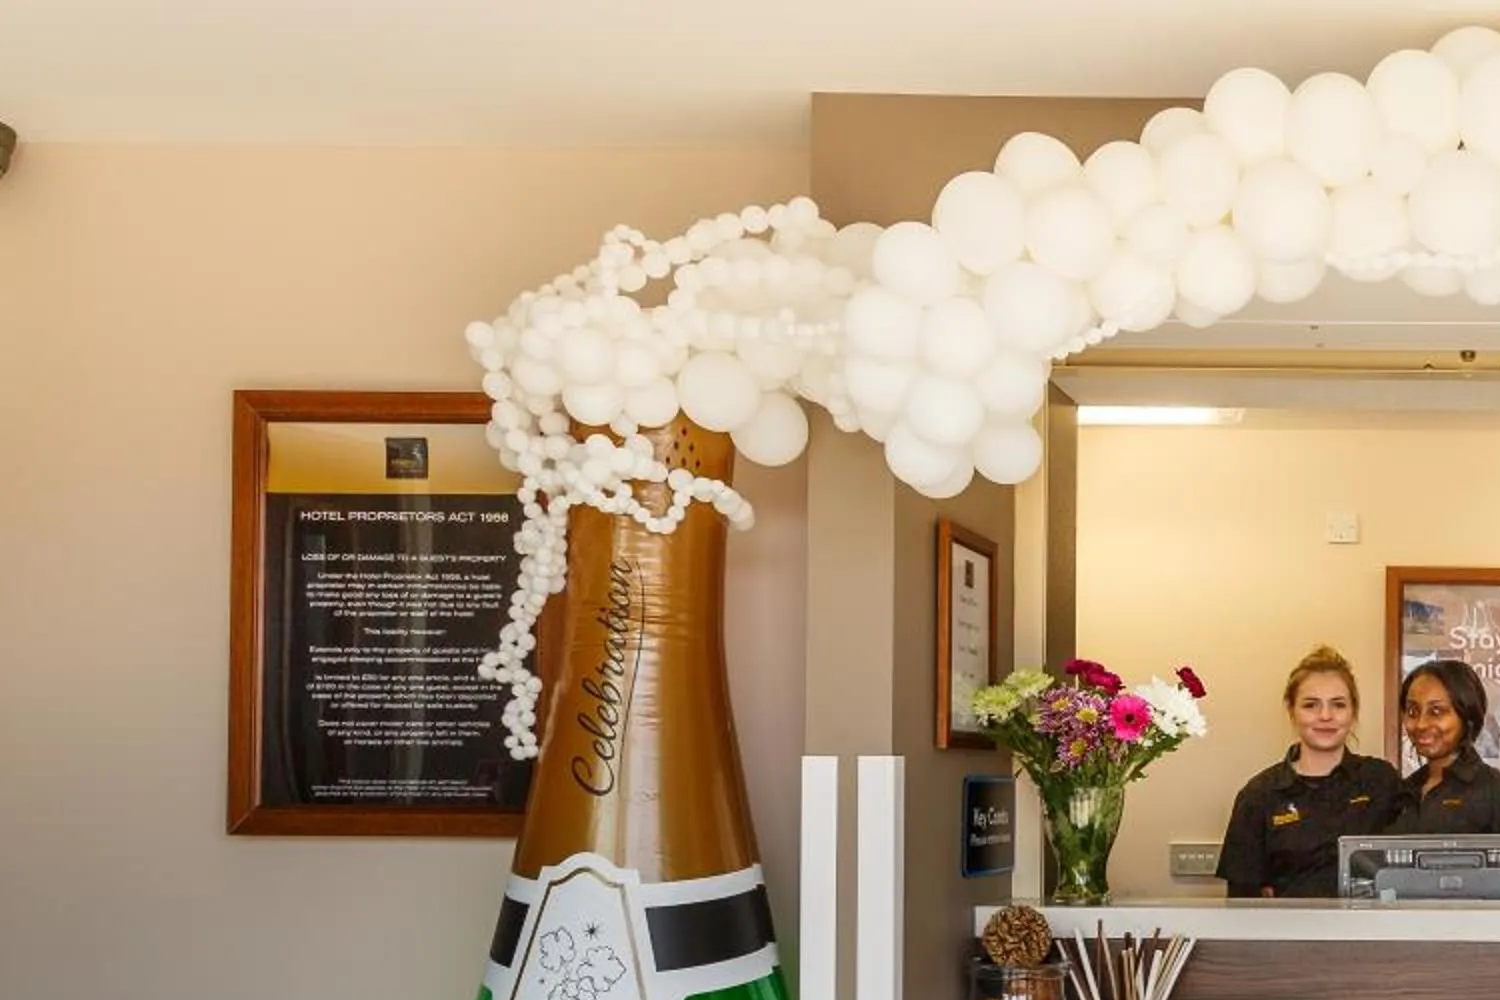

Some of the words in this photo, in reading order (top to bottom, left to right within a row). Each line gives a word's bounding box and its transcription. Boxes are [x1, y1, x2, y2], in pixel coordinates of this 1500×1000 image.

[301, 511, 345, 522] HOTEL
[348, 511, 445, 522] PROPRIETORS
[448, 512, 475, 522] ACT
[571, 556, 635, 797] Celebration
